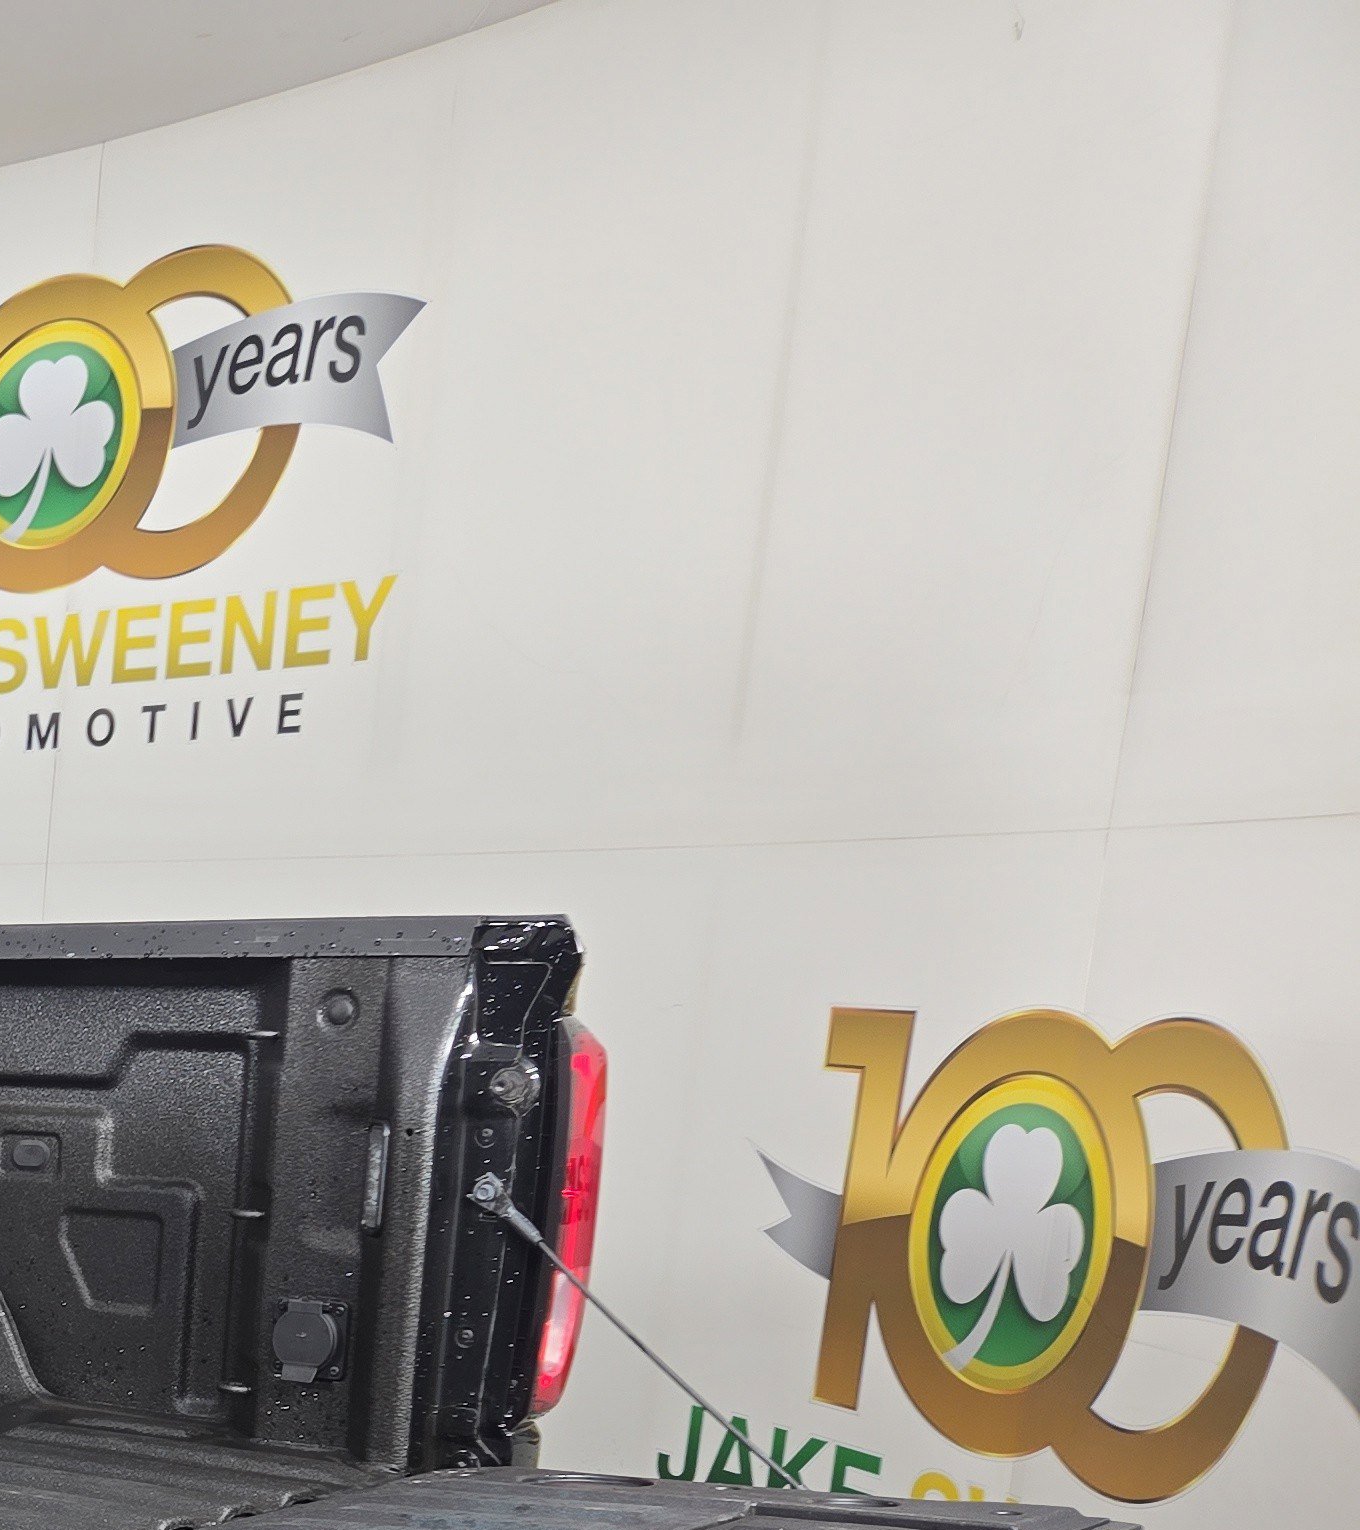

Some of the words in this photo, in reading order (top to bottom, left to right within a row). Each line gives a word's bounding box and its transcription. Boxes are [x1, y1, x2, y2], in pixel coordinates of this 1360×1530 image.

[186, 313, 365, 430] years
[813, 1007, 1290, 1504] 100
[1158, 1178, 1359, 1303] years
